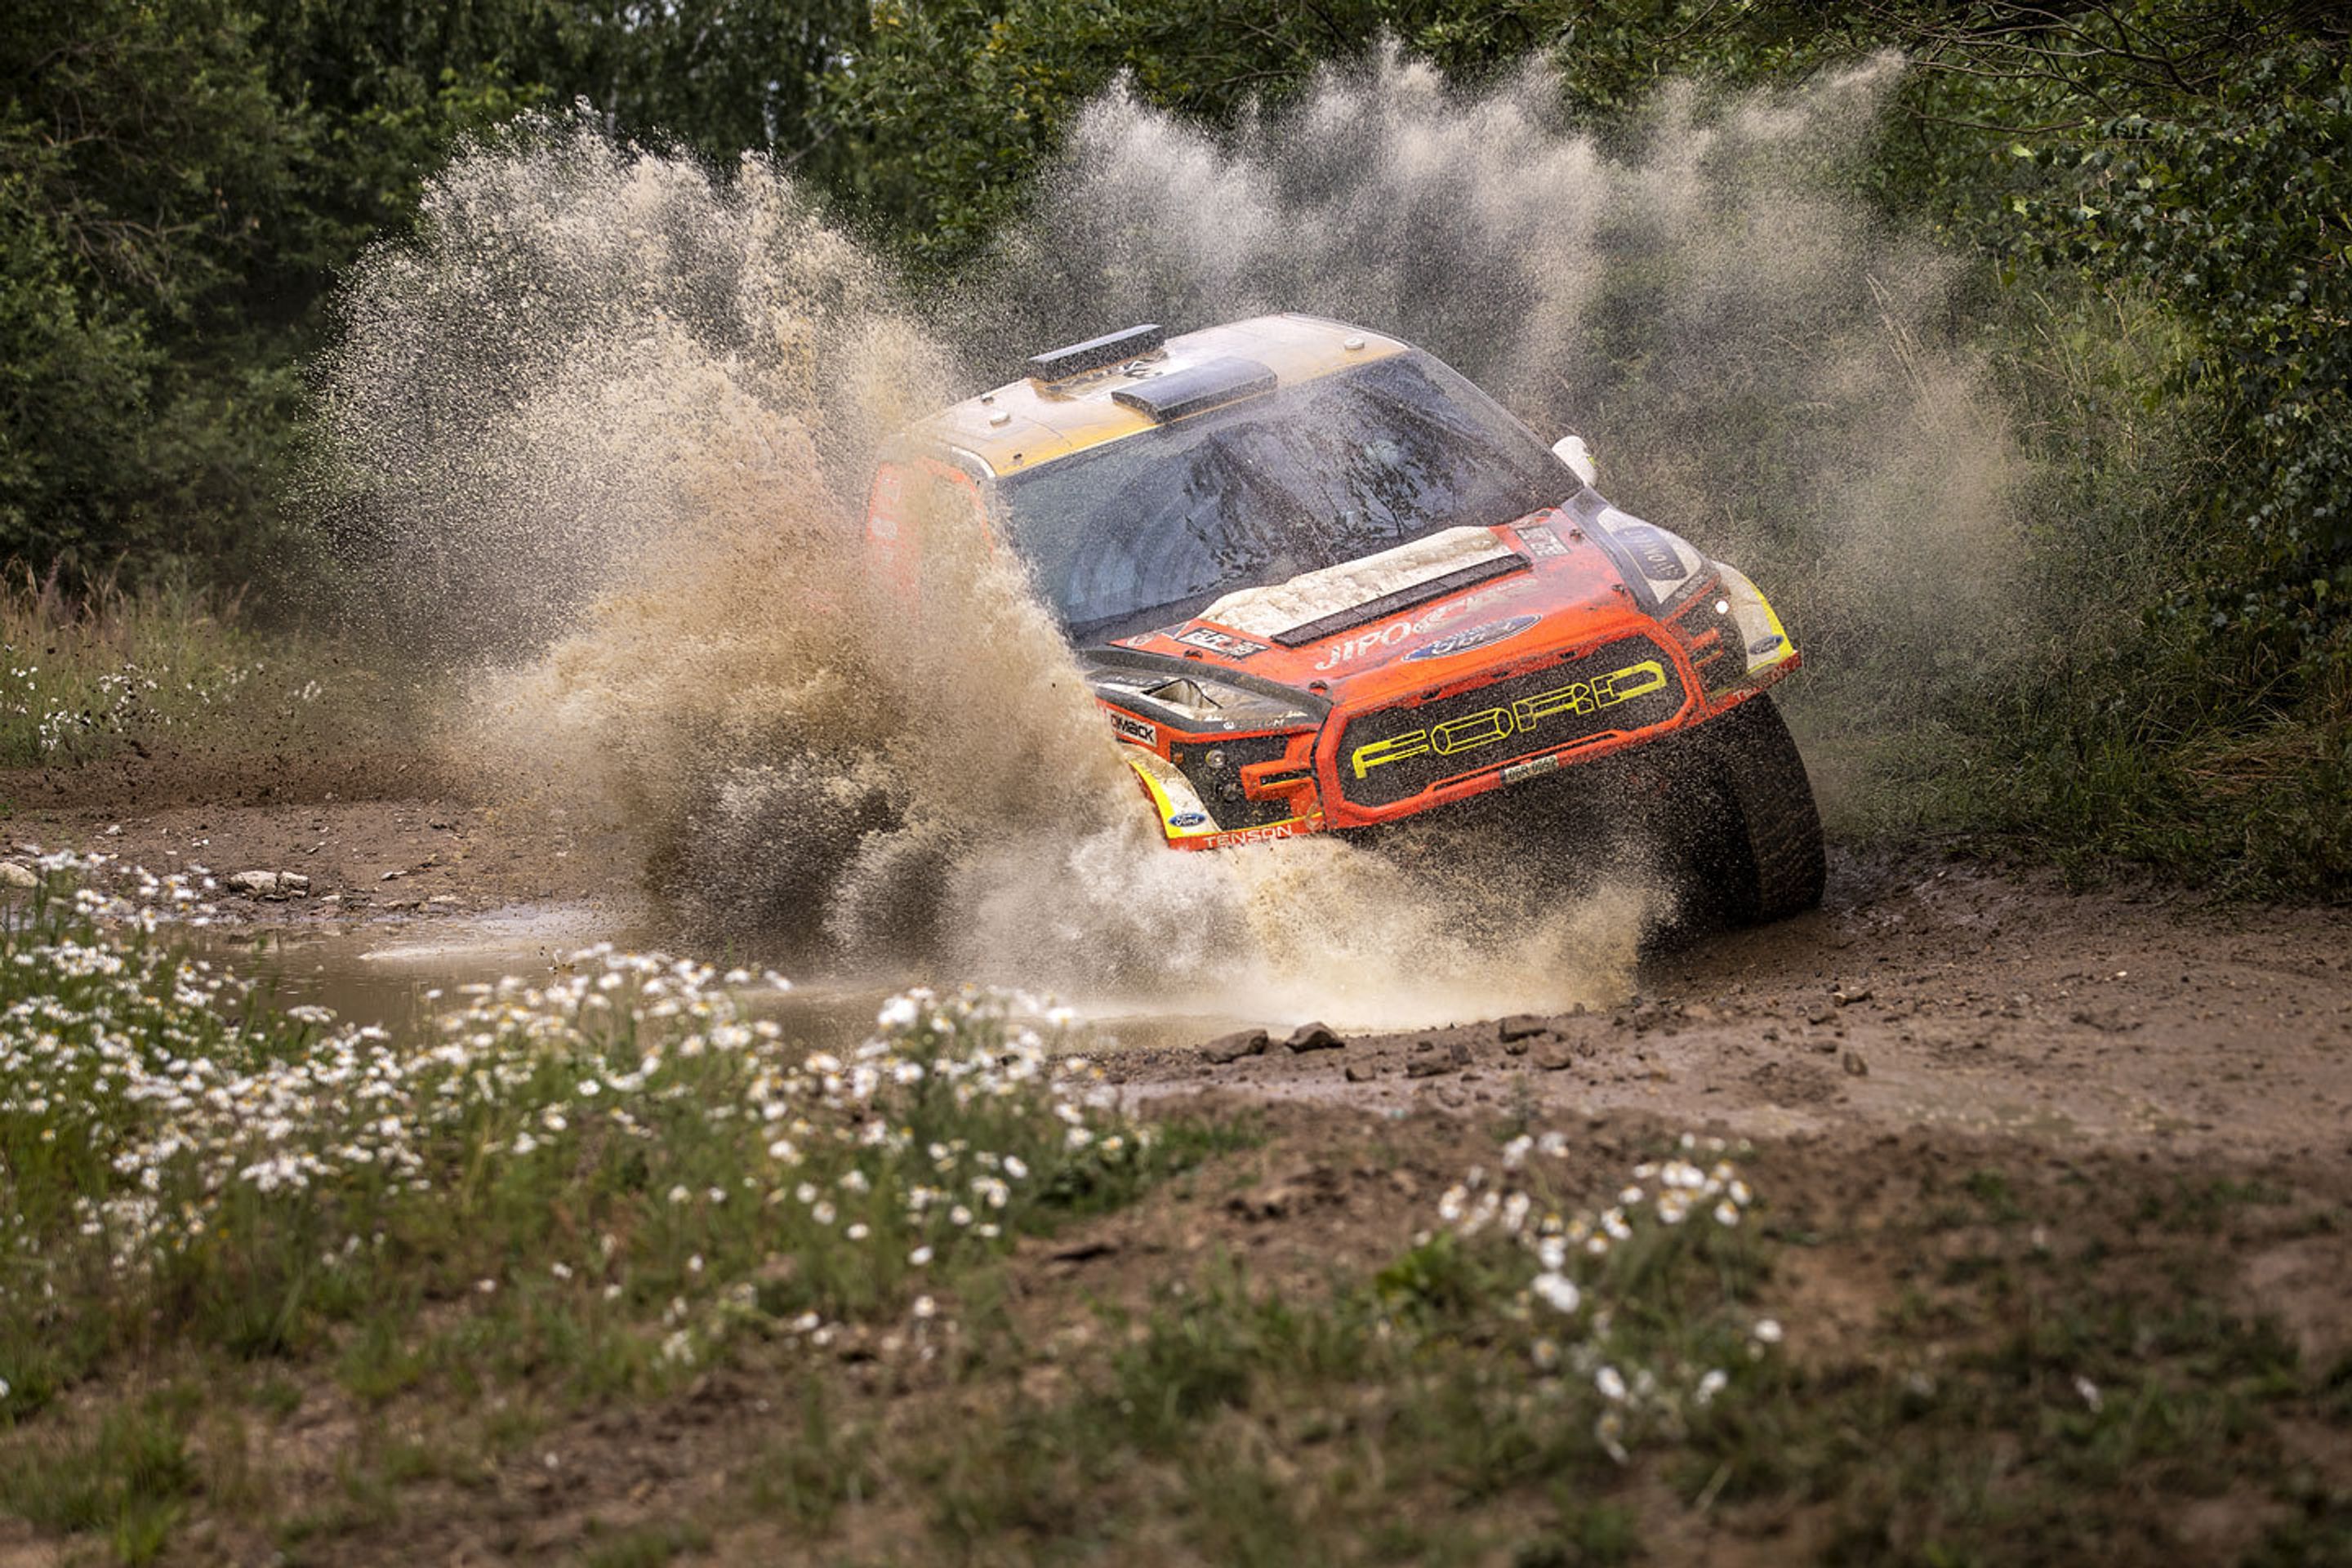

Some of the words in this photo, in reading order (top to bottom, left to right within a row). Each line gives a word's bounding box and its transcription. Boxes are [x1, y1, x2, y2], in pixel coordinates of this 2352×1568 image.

[1316, 578, 1537, 670] JIPOC
[1352, 660, 1667, 779] FORD
[1202, 824, 1292, 849] TENSON
